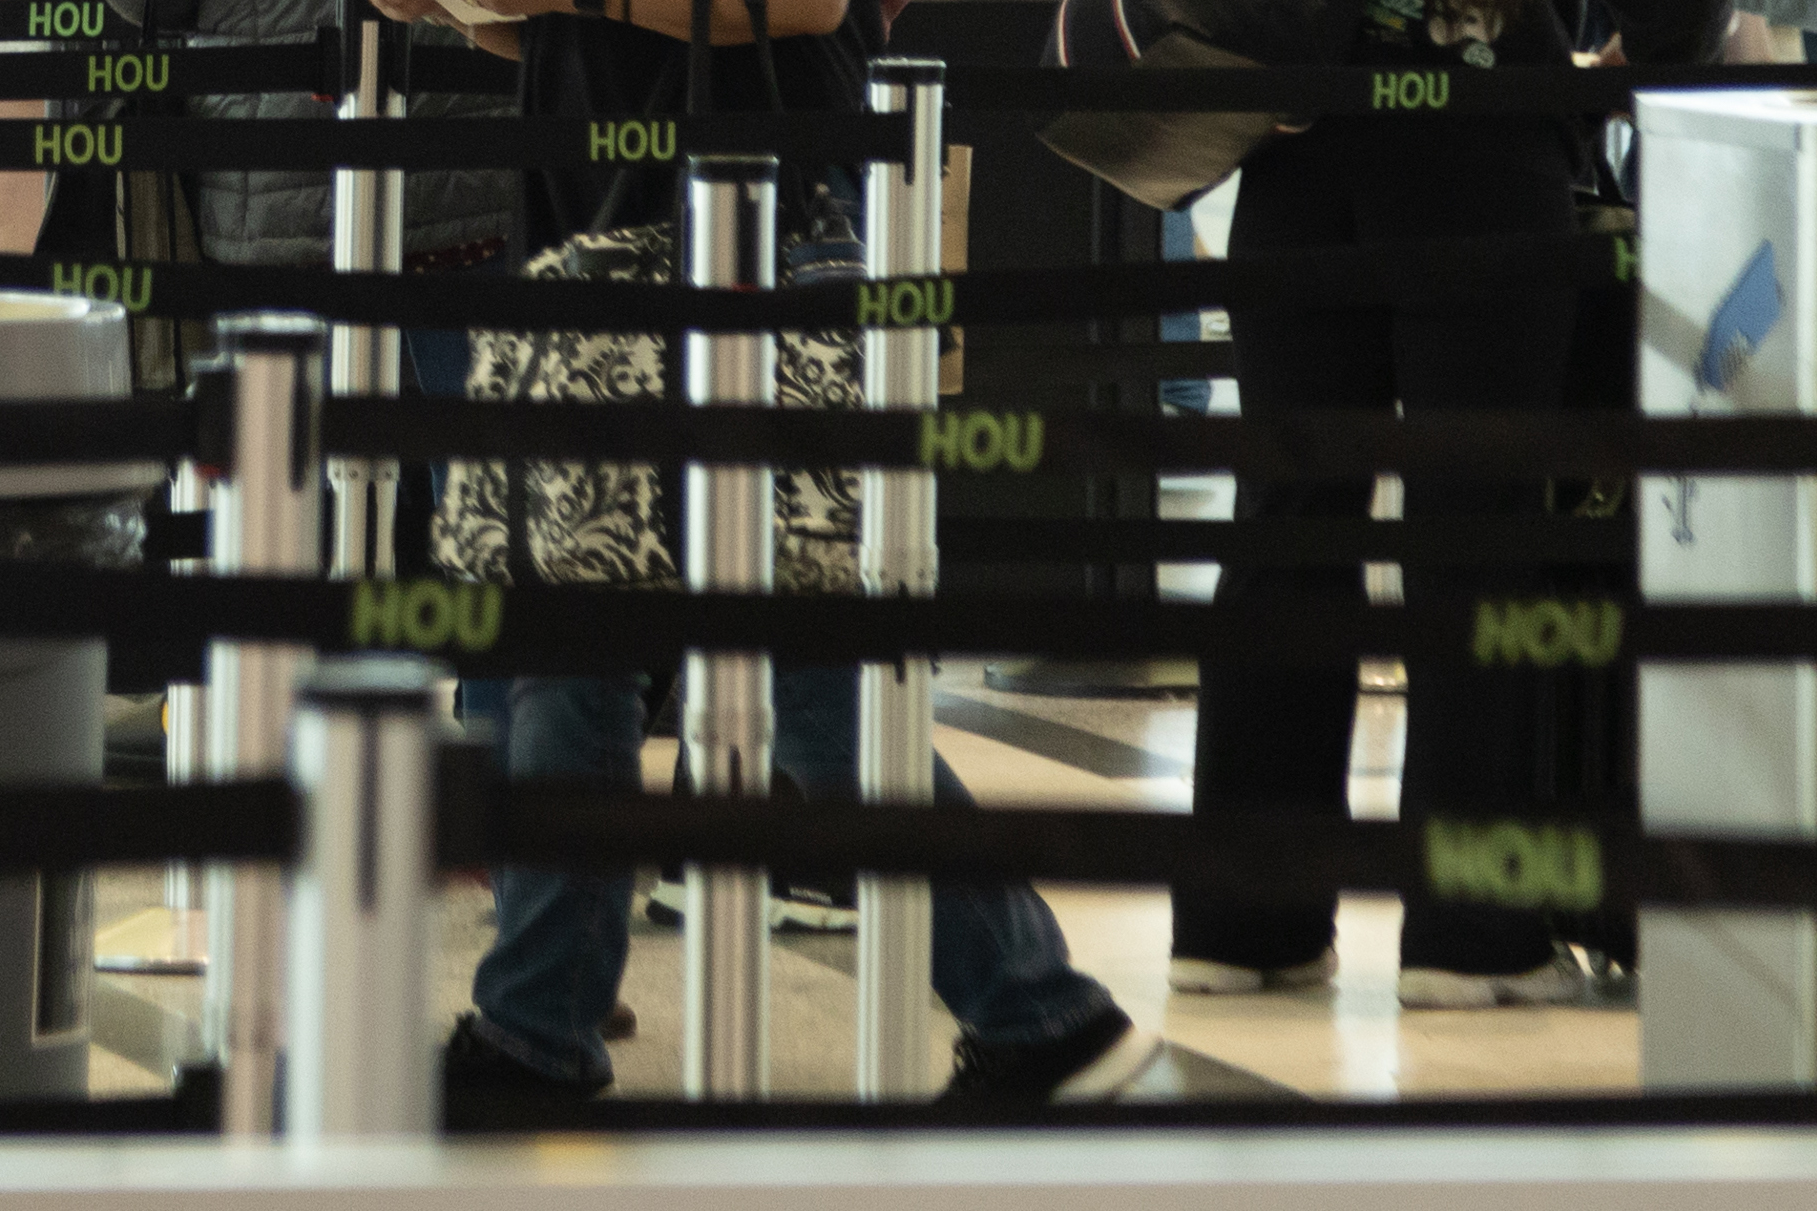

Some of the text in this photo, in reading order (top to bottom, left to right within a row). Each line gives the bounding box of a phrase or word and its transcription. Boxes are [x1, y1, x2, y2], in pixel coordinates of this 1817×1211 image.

[29, 1, 104, 37] HOU
[88, 54, 170, 92] HOU
[1372, 71, 1450, 109] HOU
[35, 123, 123, 165] HOU
[590, 121, 676, 161] HOU
[53, 263, 152, 312] HOU
[857, 279, 954, 326] HOU
[919, 411, 1044, 470] HOU
[351, 579, 502, 648] HOU
[1473, 600, 1621, 664] HOU
[1426, 822, 1602, 906] HOU
